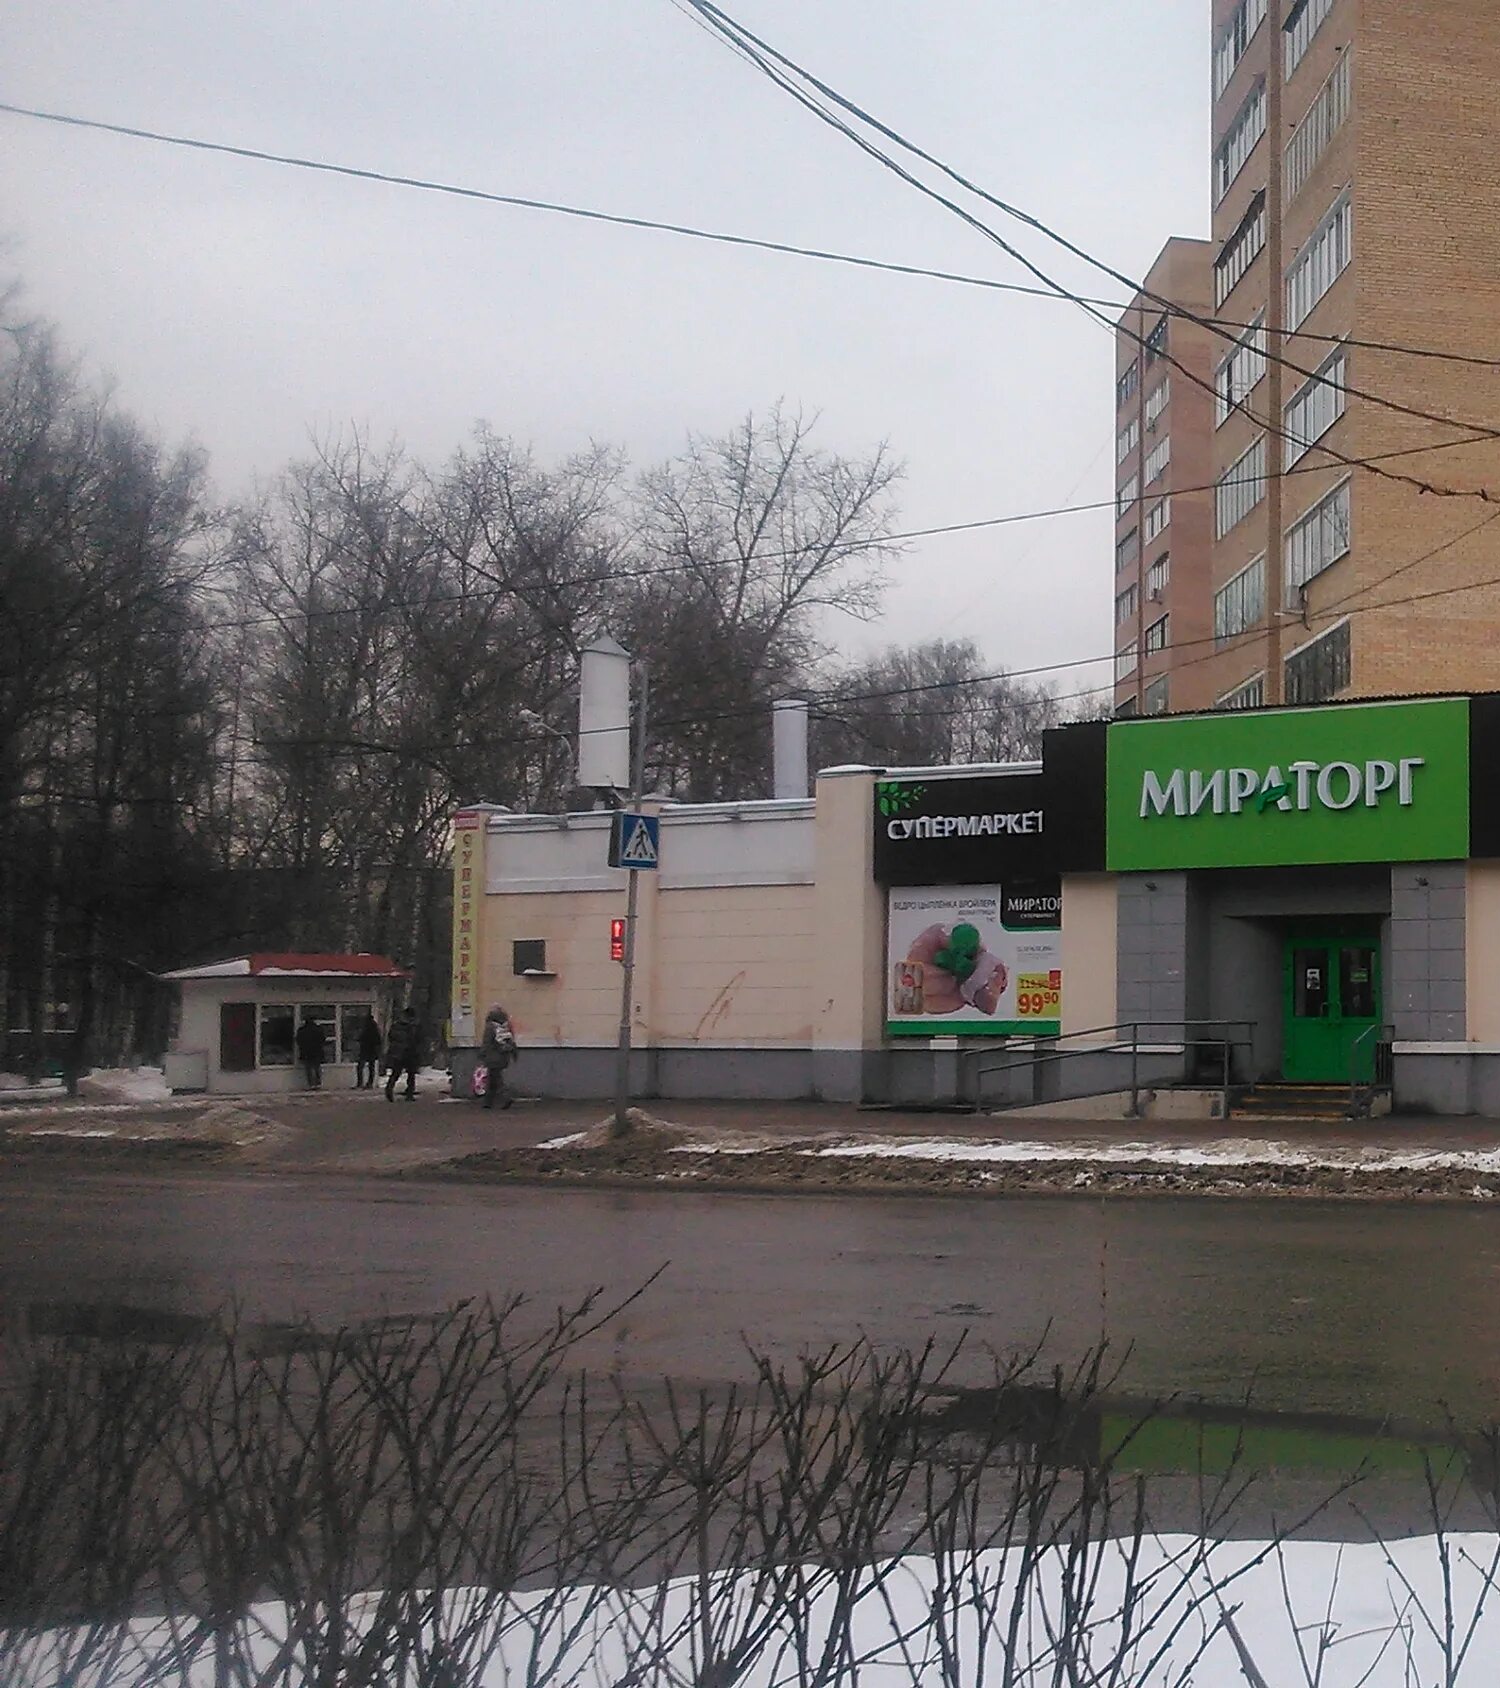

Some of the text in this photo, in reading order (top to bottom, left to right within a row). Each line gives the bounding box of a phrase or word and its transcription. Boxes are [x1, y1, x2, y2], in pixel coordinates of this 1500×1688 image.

[1140, 757, 1425, 818] МИРАТОРГ
[887, 811, 1043, 840] СУПЕРМАРКЕТ
[1007, 896, 1062, 911] МИРАТОР
